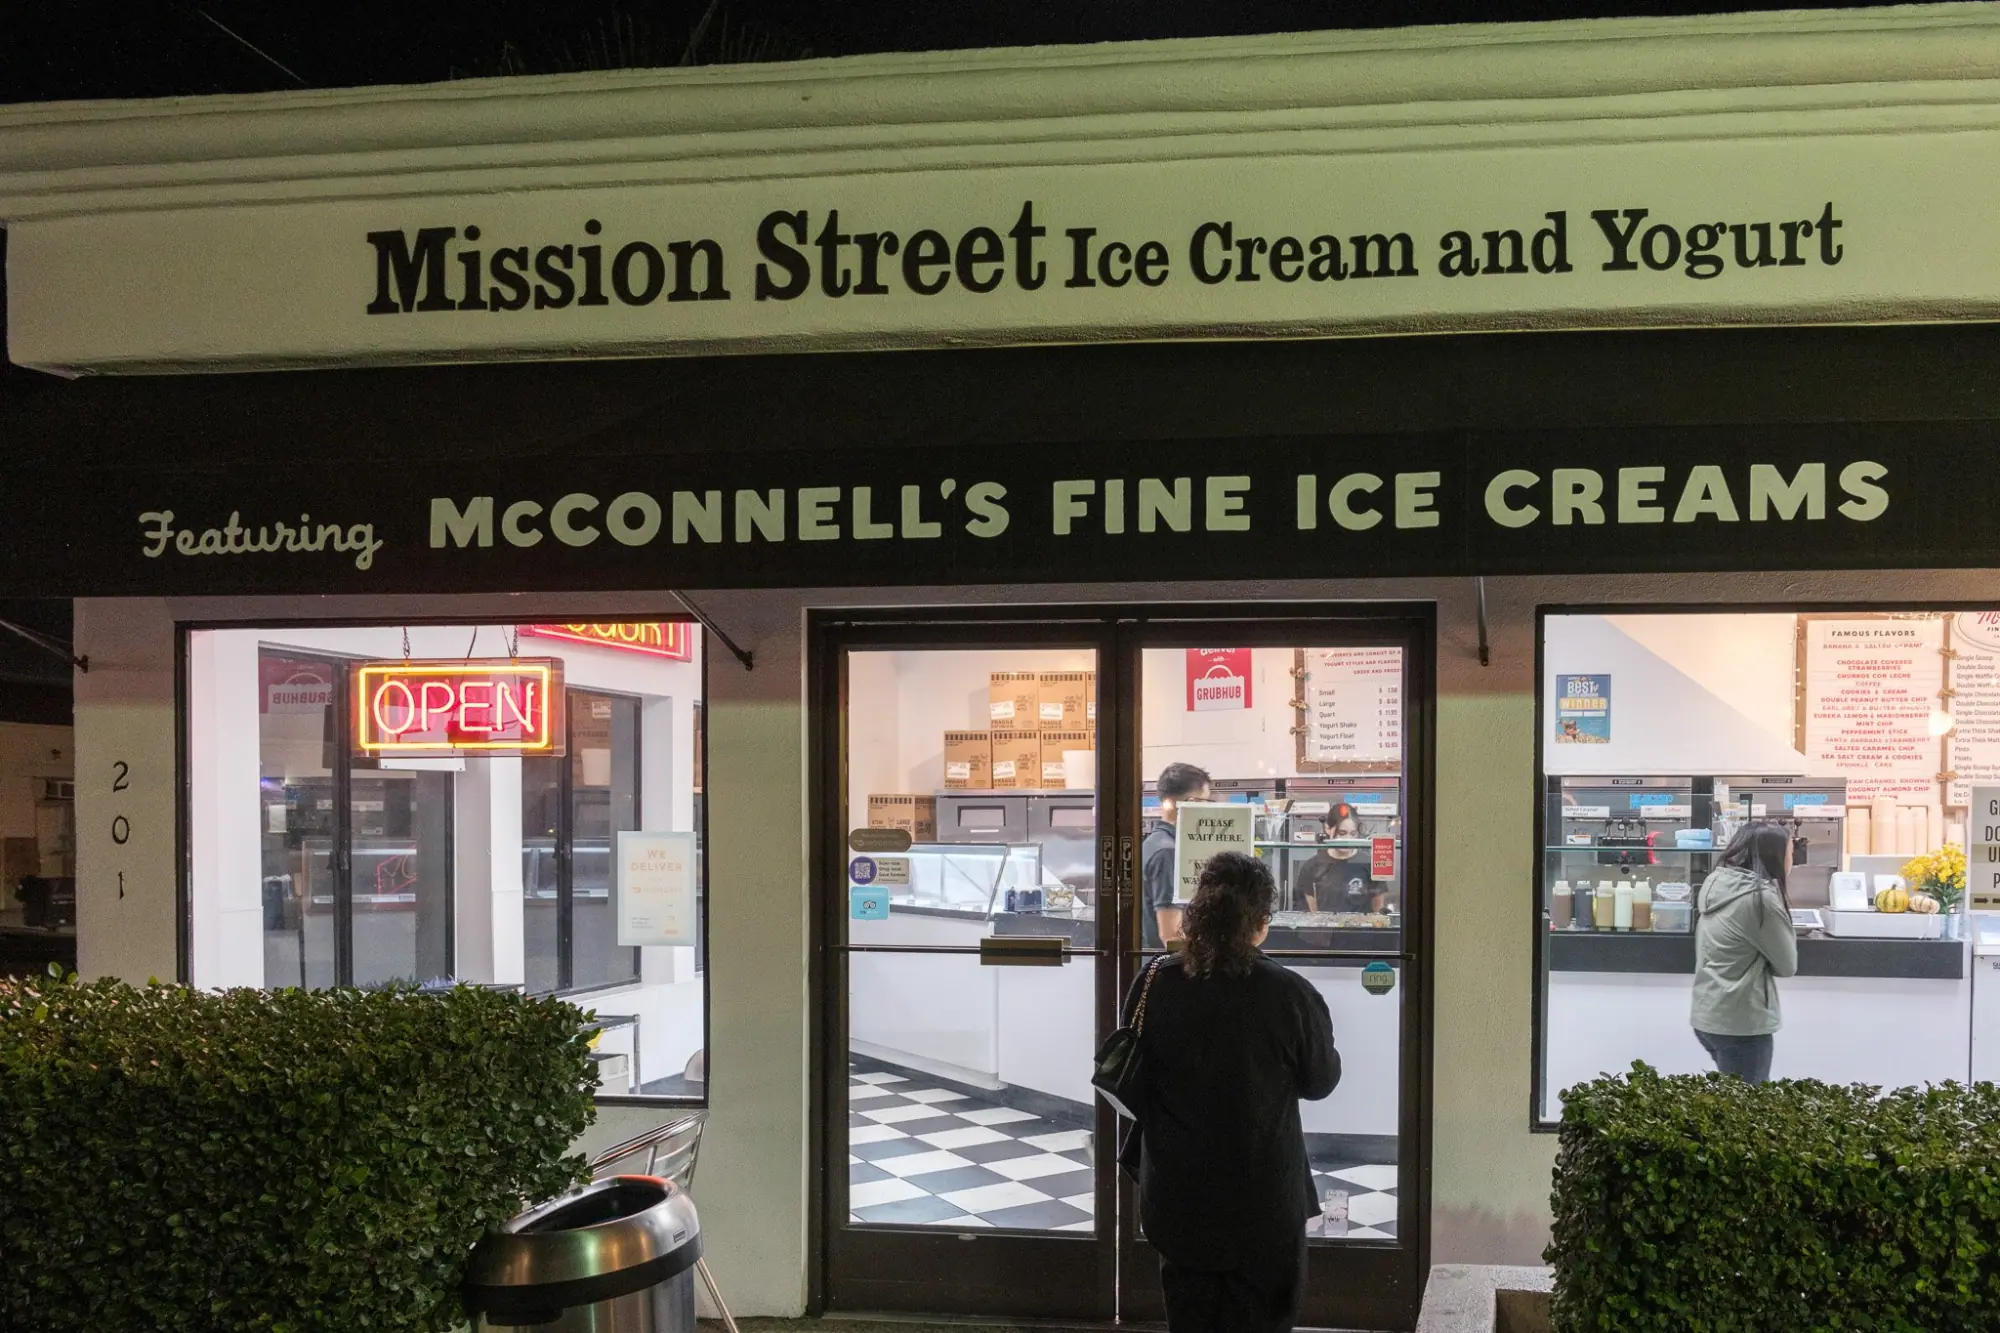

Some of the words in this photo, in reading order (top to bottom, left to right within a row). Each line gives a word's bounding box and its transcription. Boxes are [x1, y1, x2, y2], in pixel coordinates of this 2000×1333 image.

[367, 219, 730, 314] Mission
[756, 201, 1046, 300] Street
[1066, 228, 1168, 287] Ice
[1190, 222, 1418, 284] Cream
[1439, 211, 1572, 277] and
[1592, 202, 1842, 279] Yogurt
[139, 509, 383, 569] Featuring
[1053, 476, 1250, 534] FINE
[1297, 472, 1440, 530] ICE
[1485, 461, 1890, 527] CREAMS
[1196, 686, 1241, 701] GRUBHUB
[373, 680, 535, 735] OPEN
[1319, 700, 1335, 708] Large
[1320, 722, 1339, 730] Yogurt
[1320, 733, 1339, 741] Yogurt
[1343, 743, 1356, 751] Split
[1198, 819, 1233, 827] PLEASE
[1188, 833, 1213, 842] WAIT
[1215, 834, 1244, 842] HERE.
[646, 849, 667, 860] WE
[1103, 842, 1112, 880] PULL
[1122, 842, 1132, 880] PULL
[631, 862, 683, 872] DELIVER
[1369, 973, 1388, 985] ring
